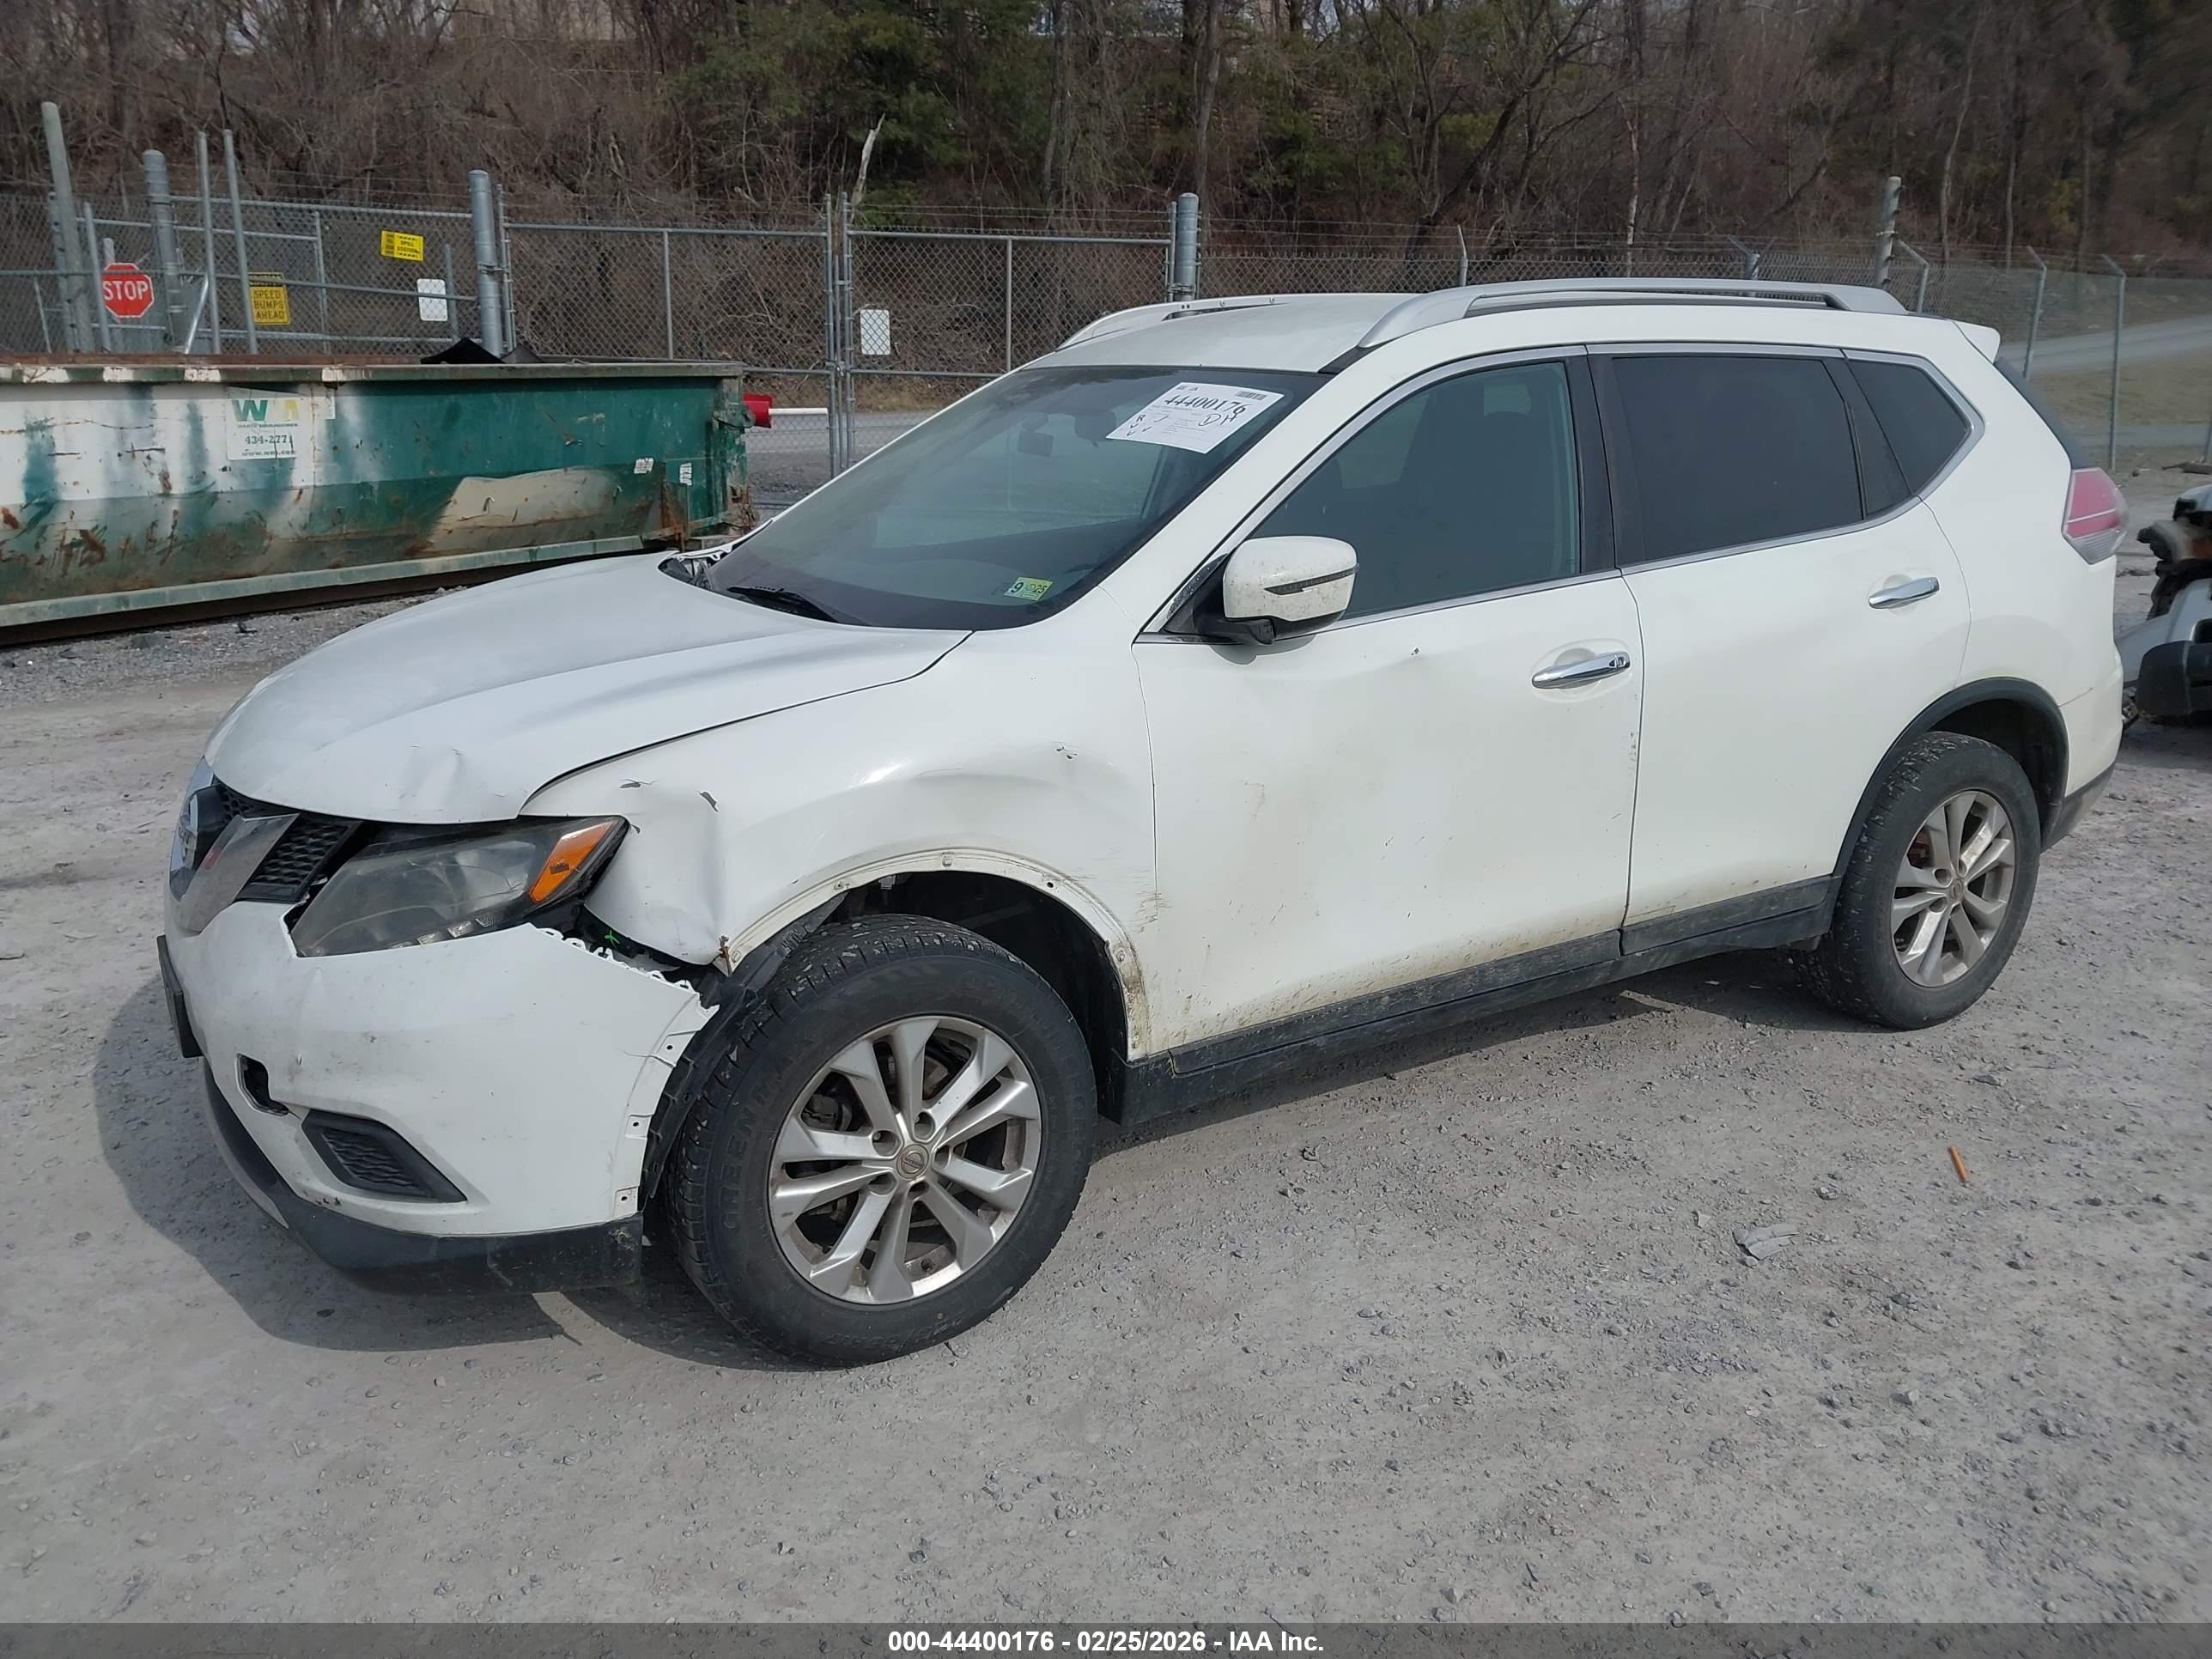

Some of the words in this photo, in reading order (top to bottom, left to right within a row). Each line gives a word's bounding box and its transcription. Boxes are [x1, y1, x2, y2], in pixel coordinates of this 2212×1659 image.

[102, 280, 149, 301] STOP
[253, 290, 282, 299] SPEED
[253, 301, 284, 309] BUMPS
[256, 311, 285, 319] AHEAD
[1164, 394, 1253, 414] 44400176
[1011, 581, 1024, 593] 9
[1032, 584, 1048, 593] 25
